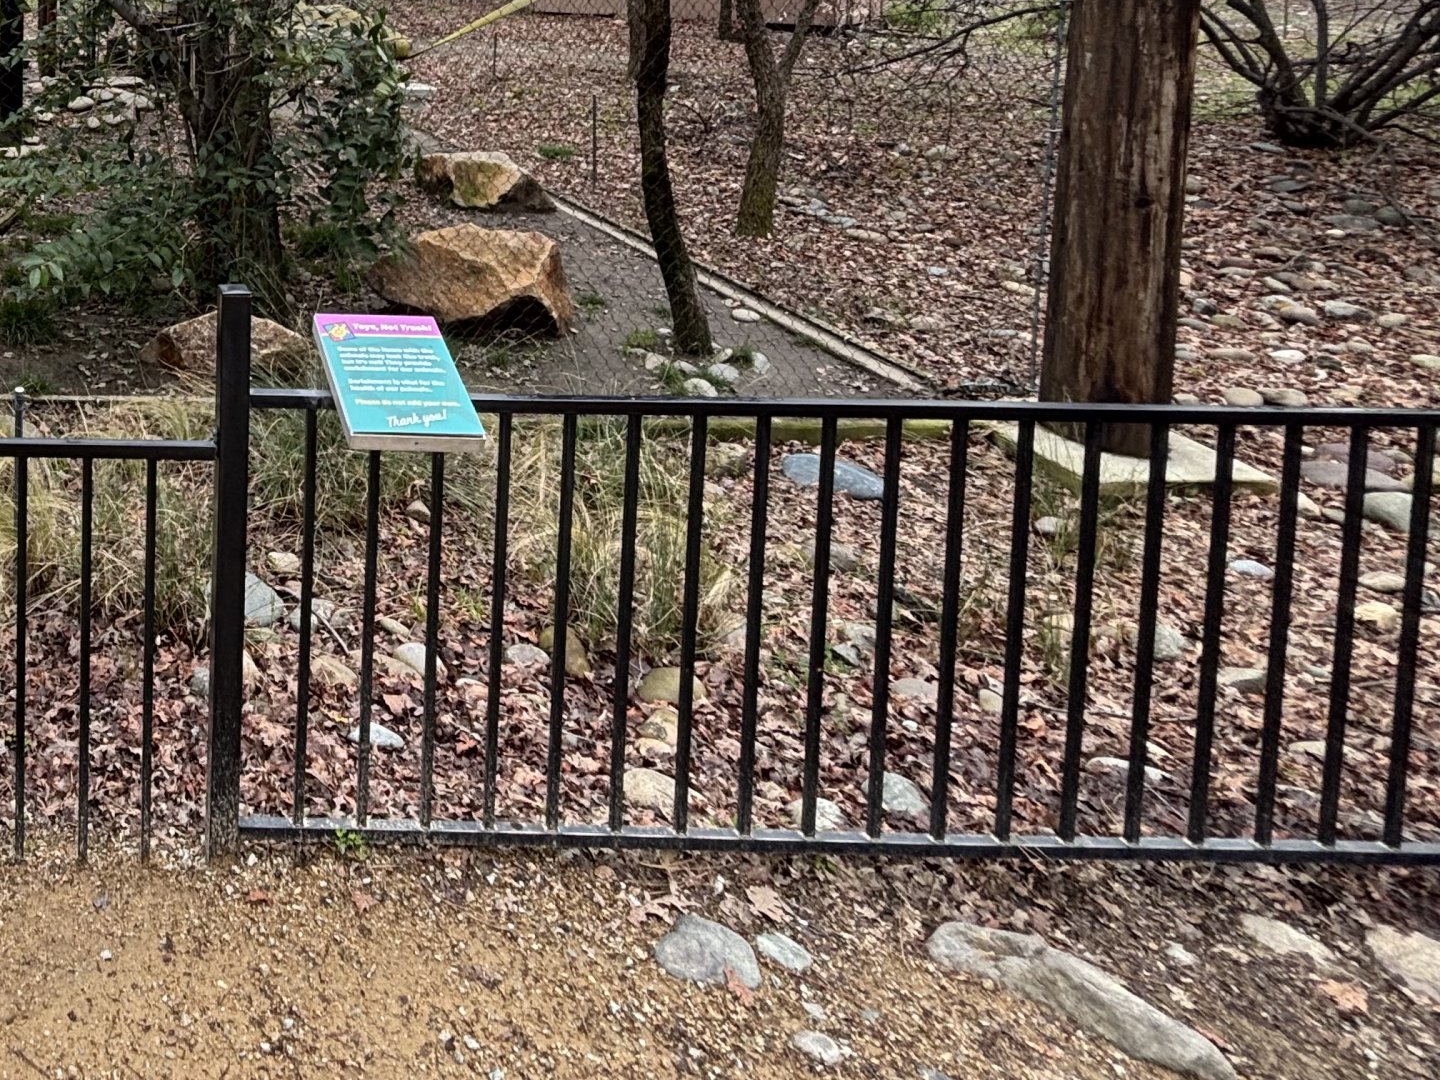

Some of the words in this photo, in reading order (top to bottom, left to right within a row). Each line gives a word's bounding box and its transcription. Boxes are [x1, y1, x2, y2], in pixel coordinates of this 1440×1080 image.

[352, 323, 380, 332] Toys,
[400, 324, 433, 332] Trash!
[386, 412, 422, 428] Thank
[422, 408, 447, 428] you!
